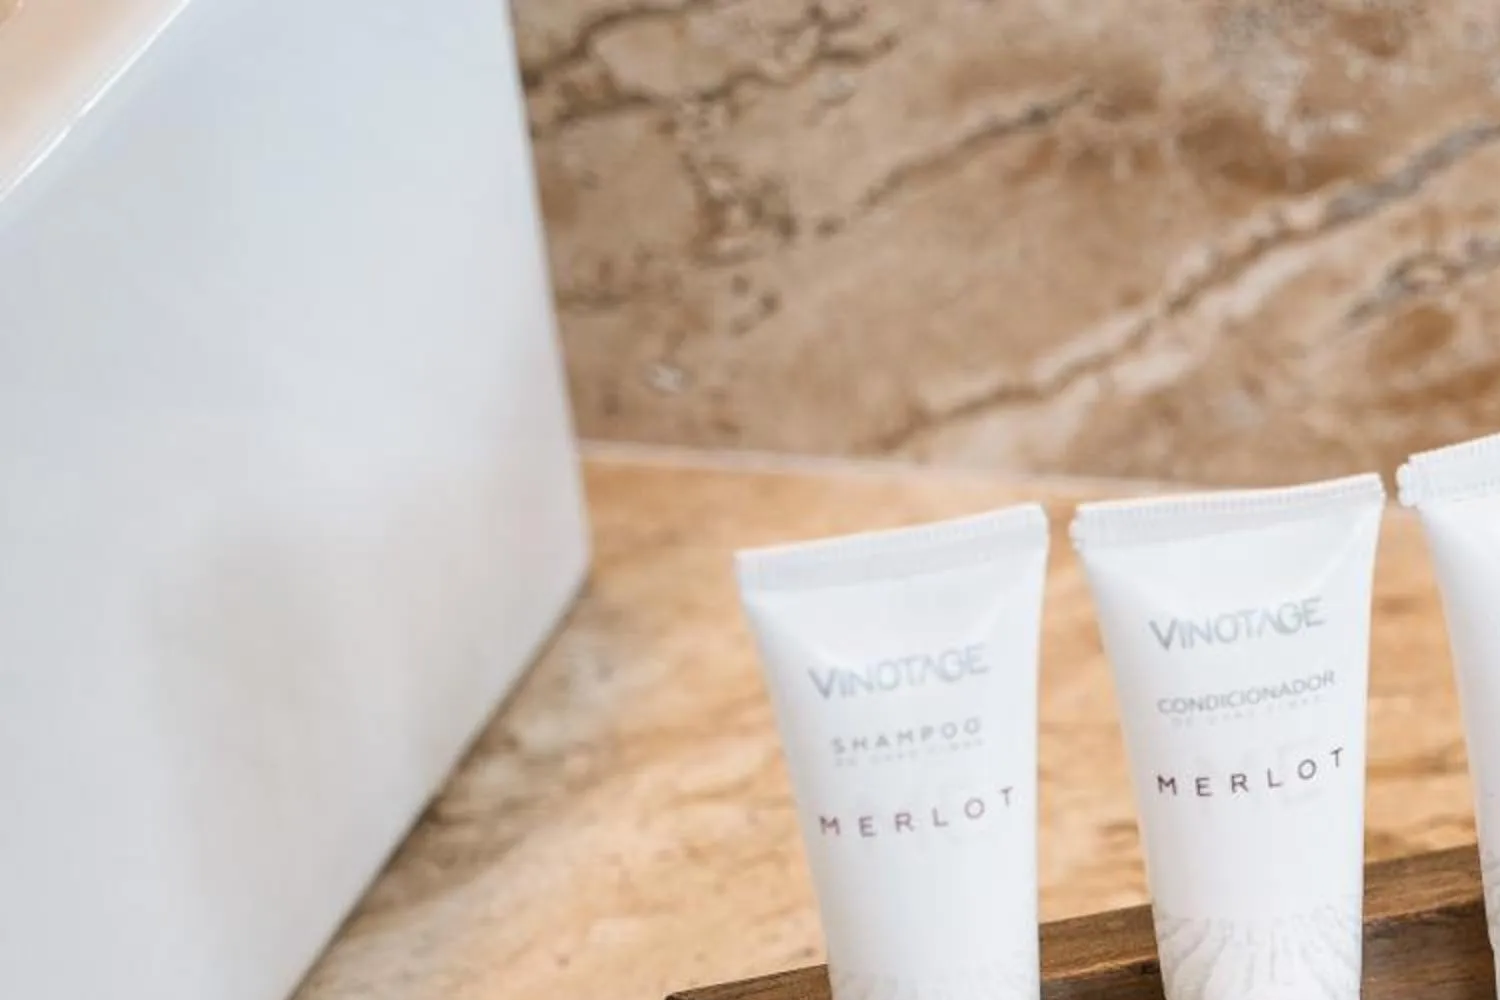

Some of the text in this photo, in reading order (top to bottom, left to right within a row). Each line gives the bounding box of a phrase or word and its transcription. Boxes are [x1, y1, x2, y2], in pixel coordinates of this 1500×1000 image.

[1149, 595, 1326, 650] VINOTAGE
[807, 643, 992, 700] VINOTAGE
[1156, 669, 1336, 714] CONDICIONADOR
[831, 716, 982, 754] SHAMPOO
[1156, 747, 1344, 797] MERLOT
[819, 785, 1013, 838] MERLOT
